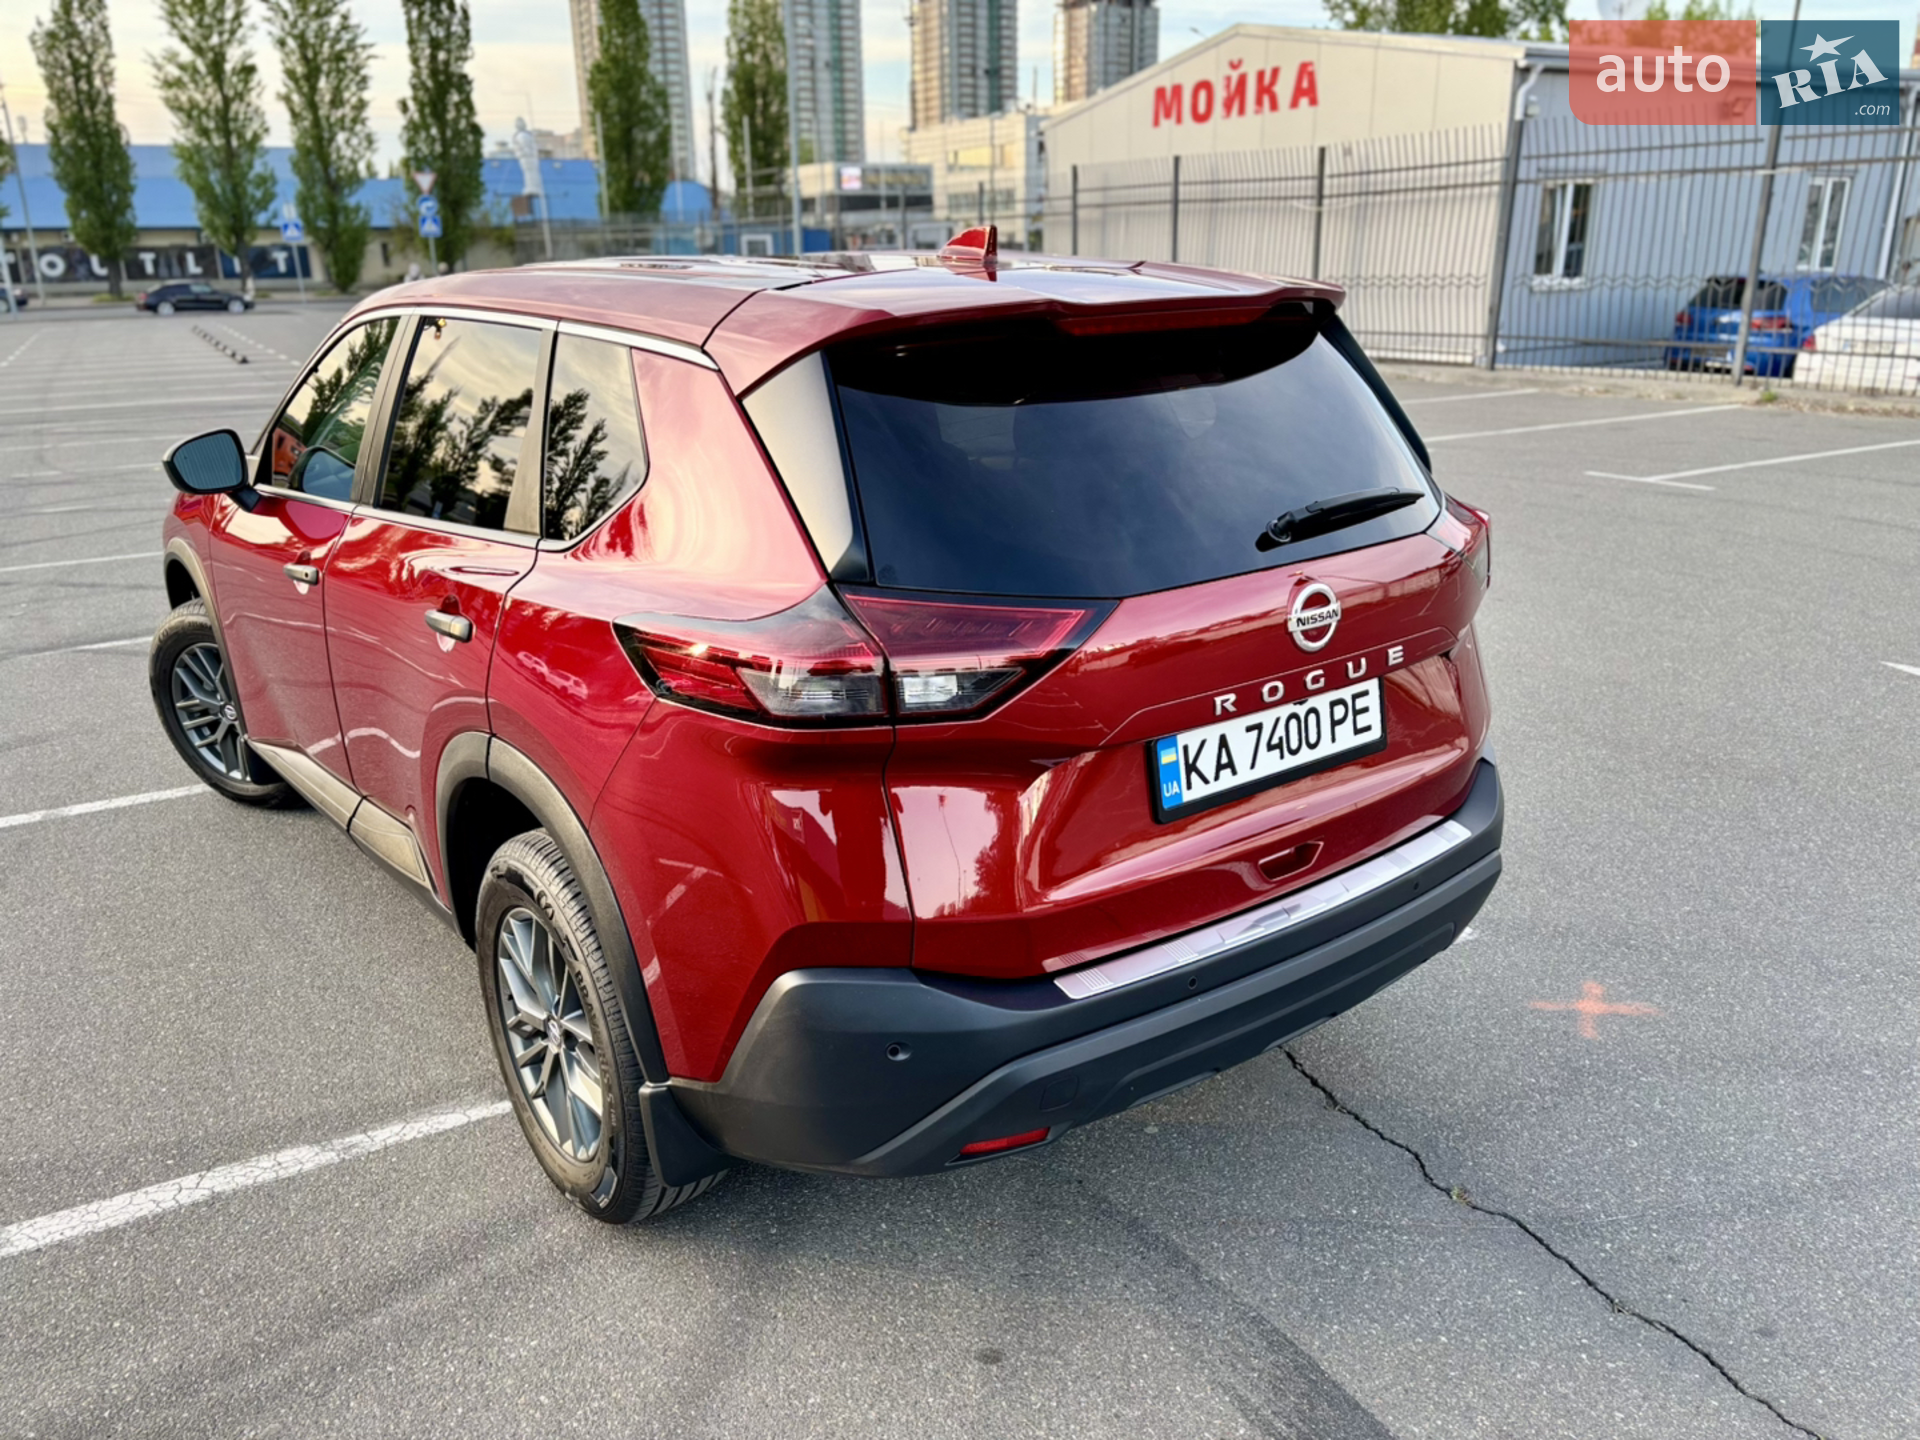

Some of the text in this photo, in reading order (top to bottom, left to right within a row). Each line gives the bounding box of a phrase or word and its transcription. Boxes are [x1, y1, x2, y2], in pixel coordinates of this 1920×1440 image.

[1152, 58, 1319, 128] МОЙКА
[1296, 608, 1339, 627] NISSAN
[1214, 645, 1404, 715] ROGUE
[1245, 706, 1322, 770] 7400
[1163, 781, 1180, 797] UA
